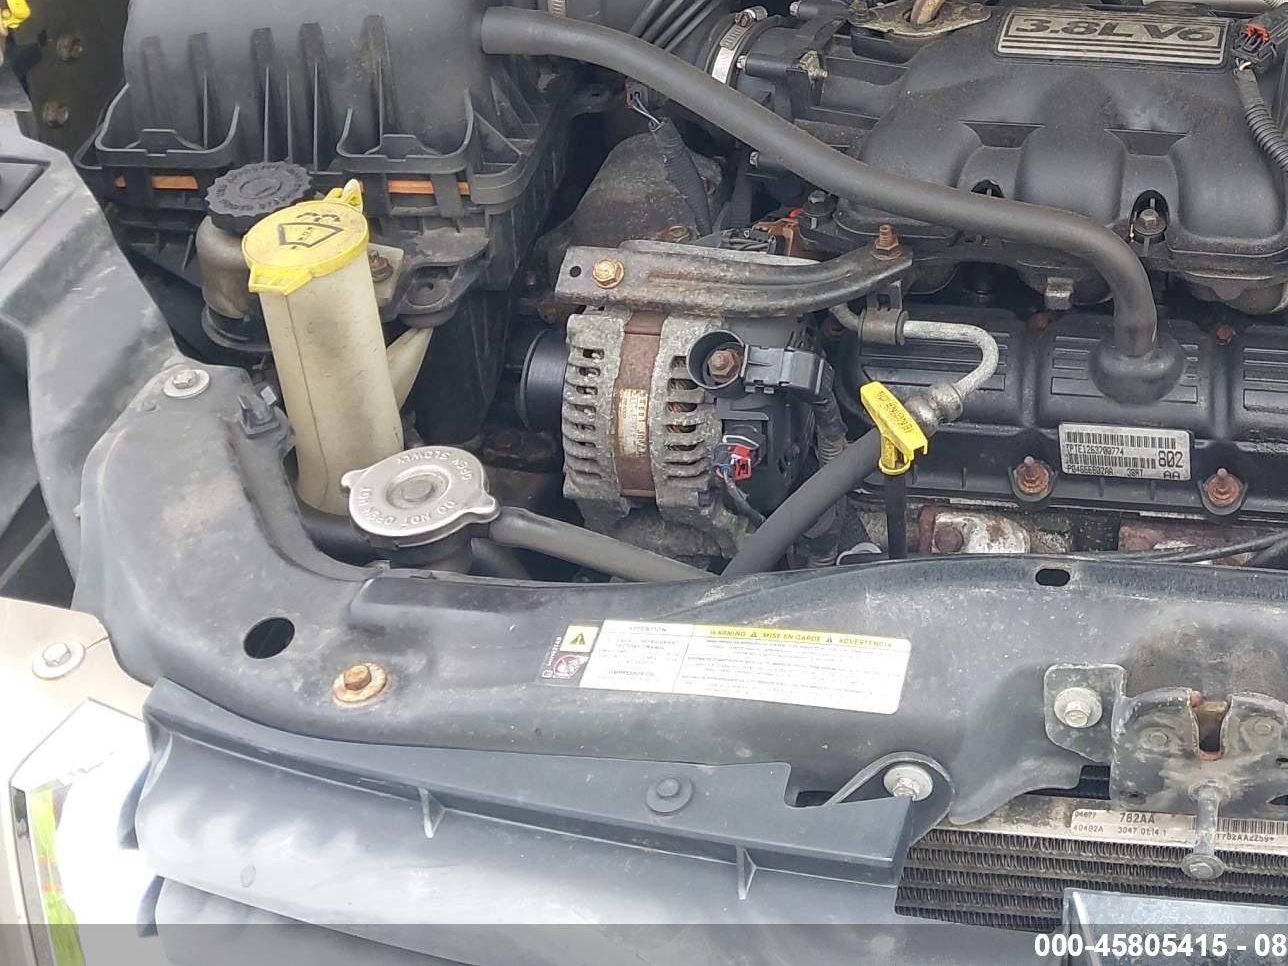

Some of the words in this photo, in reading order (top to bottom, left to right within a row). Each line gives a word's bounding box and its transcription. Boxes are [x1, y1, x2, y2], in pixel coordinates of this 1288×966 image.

[1015, 17, 1134, 39] 3.8L
[1143, 21, 1217, 42] V6
[396, 449, 452, 466] SLOWLY
[1158, 450, 1183, 468] 802
[1163, 470, 1180, 480] AA
[362, 505, 397, 526] OPEN
[436, 499, 458, 515] DO
[399, 513, 432, 527] NOT
